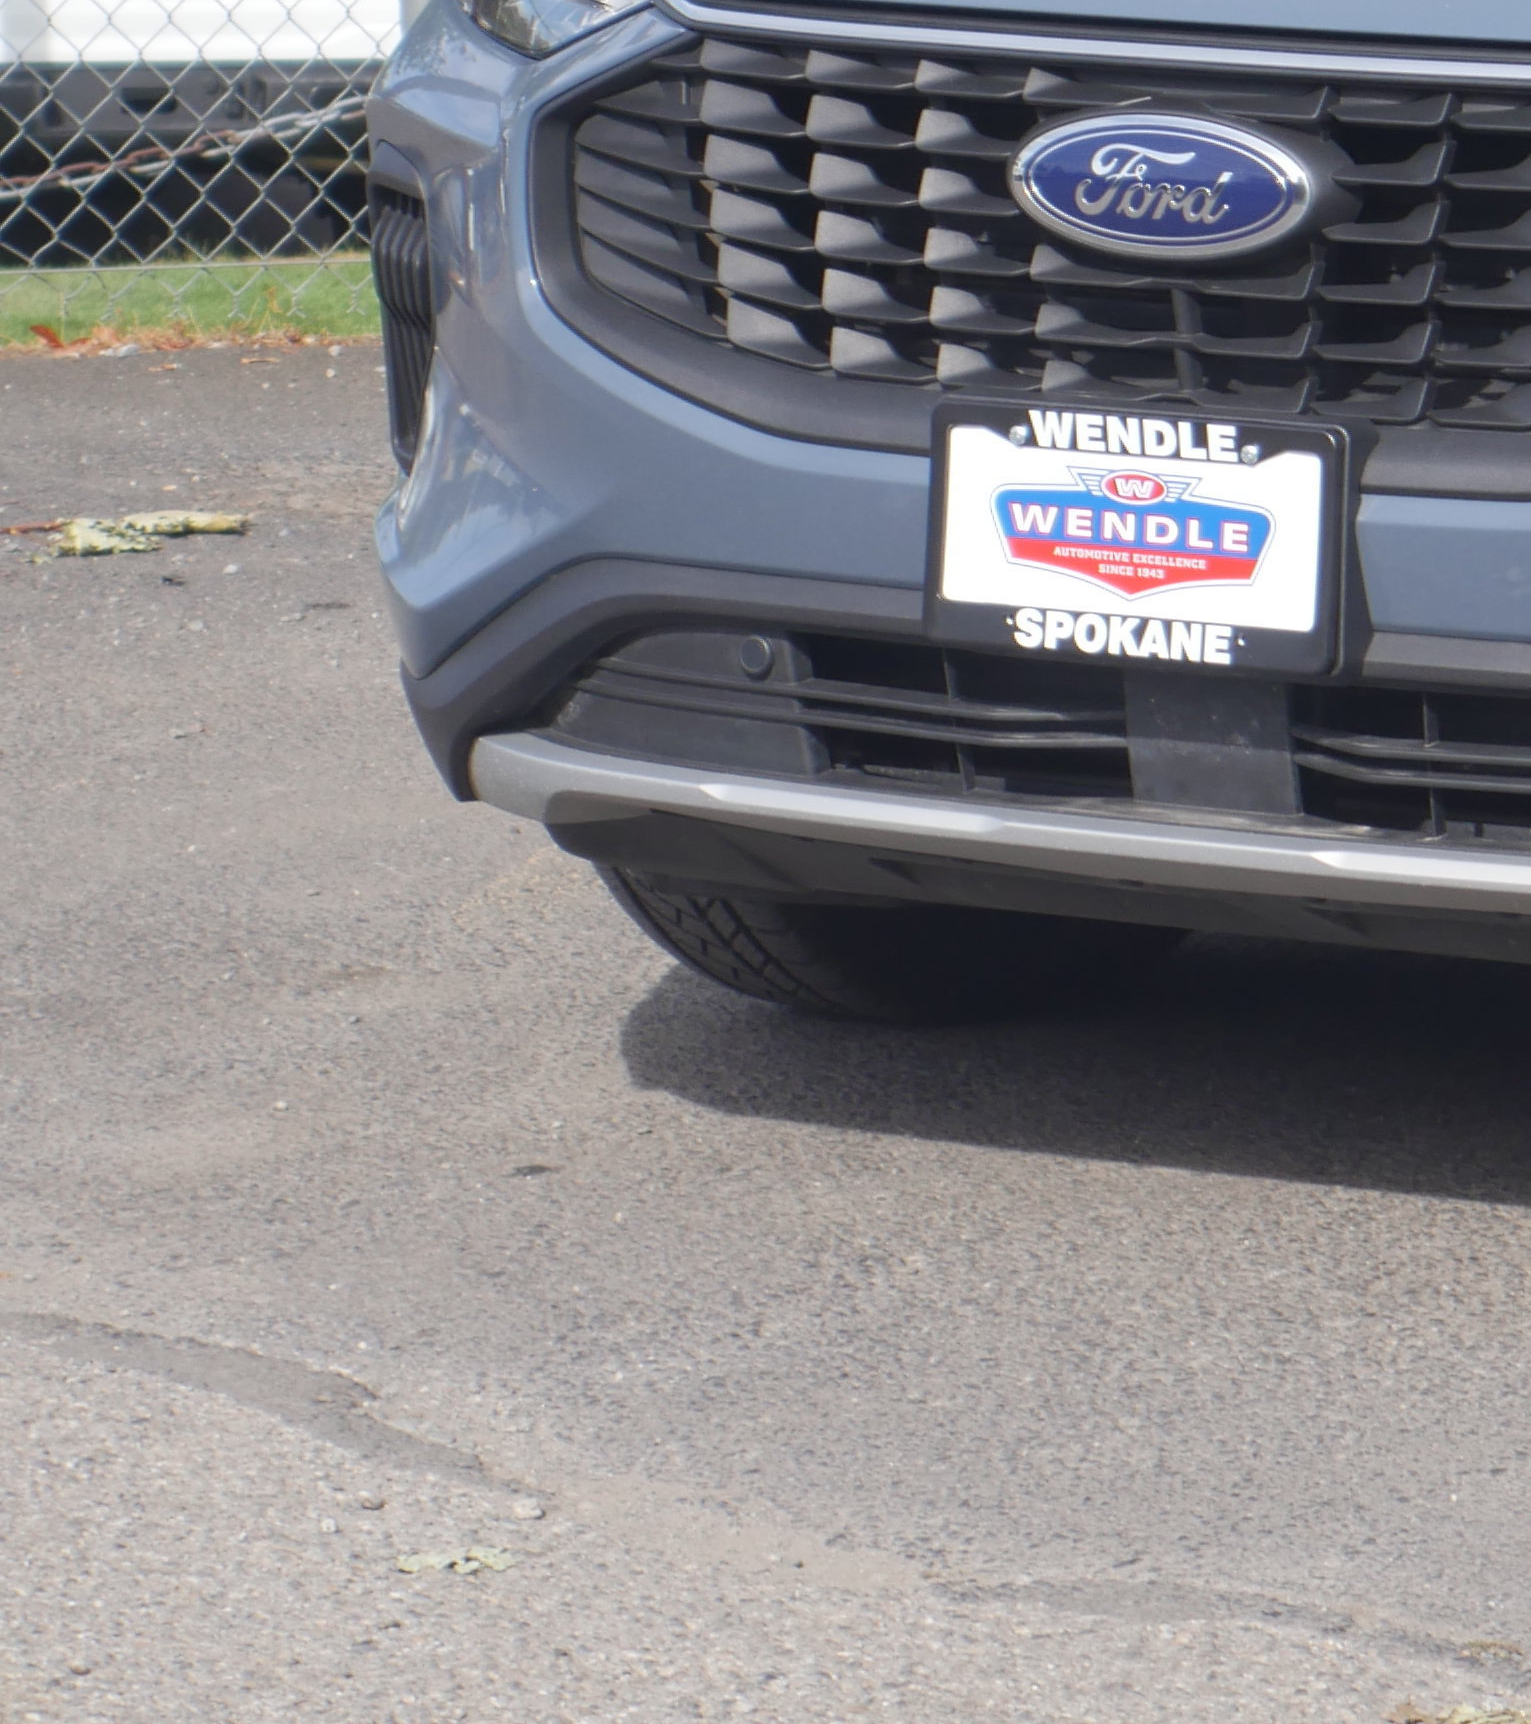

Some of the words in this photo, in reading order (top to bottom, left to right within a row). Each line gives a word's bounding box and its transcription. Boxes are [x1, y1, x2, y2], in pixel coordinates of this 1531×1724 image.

[1074, 142, 1235, 225] Ford
[1028, 410, 1240, 462] WENDLE
[1009, 502, 1249, 552] WENDLE
[1053, 546, 1129, 563] AUTOMOTIVE
[1132, 553, 1206, 570] EXCELLENCE
[1098, 563, 1133, 577] SINCE
[1137, 567, 1165, 579] 1943
[1013, 607, 1233, 665] SPOKANE
